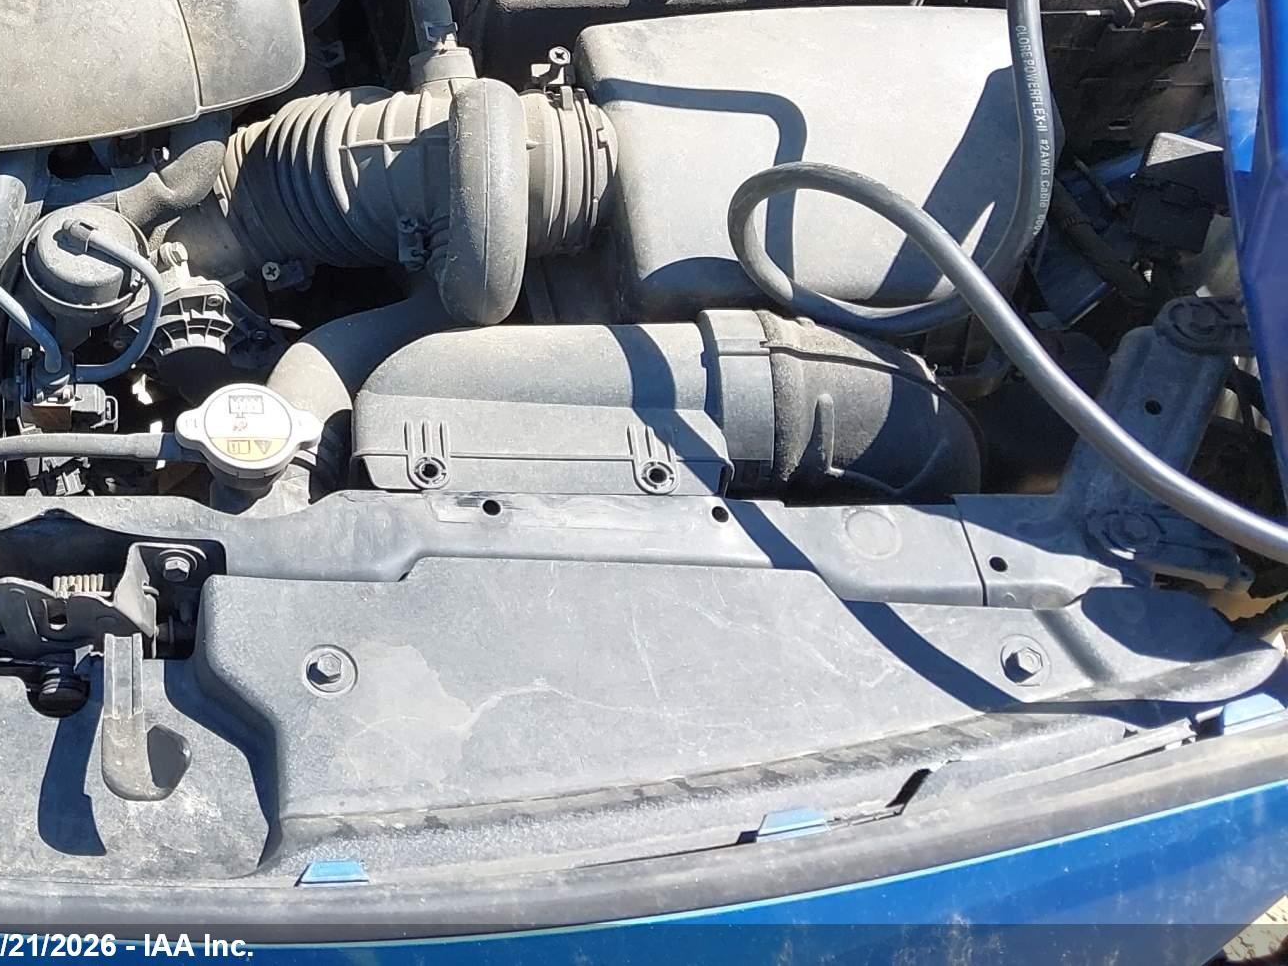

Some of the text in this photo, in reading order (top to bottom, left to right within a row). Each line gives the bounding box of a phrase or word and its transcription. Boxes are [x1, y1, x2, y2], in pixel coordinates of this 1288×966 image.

[1015, 25, 1033, 58] CLORE
[1039, 139, 1051, 176] #2AWG
[1039, 180, 1051, 209] Cable
